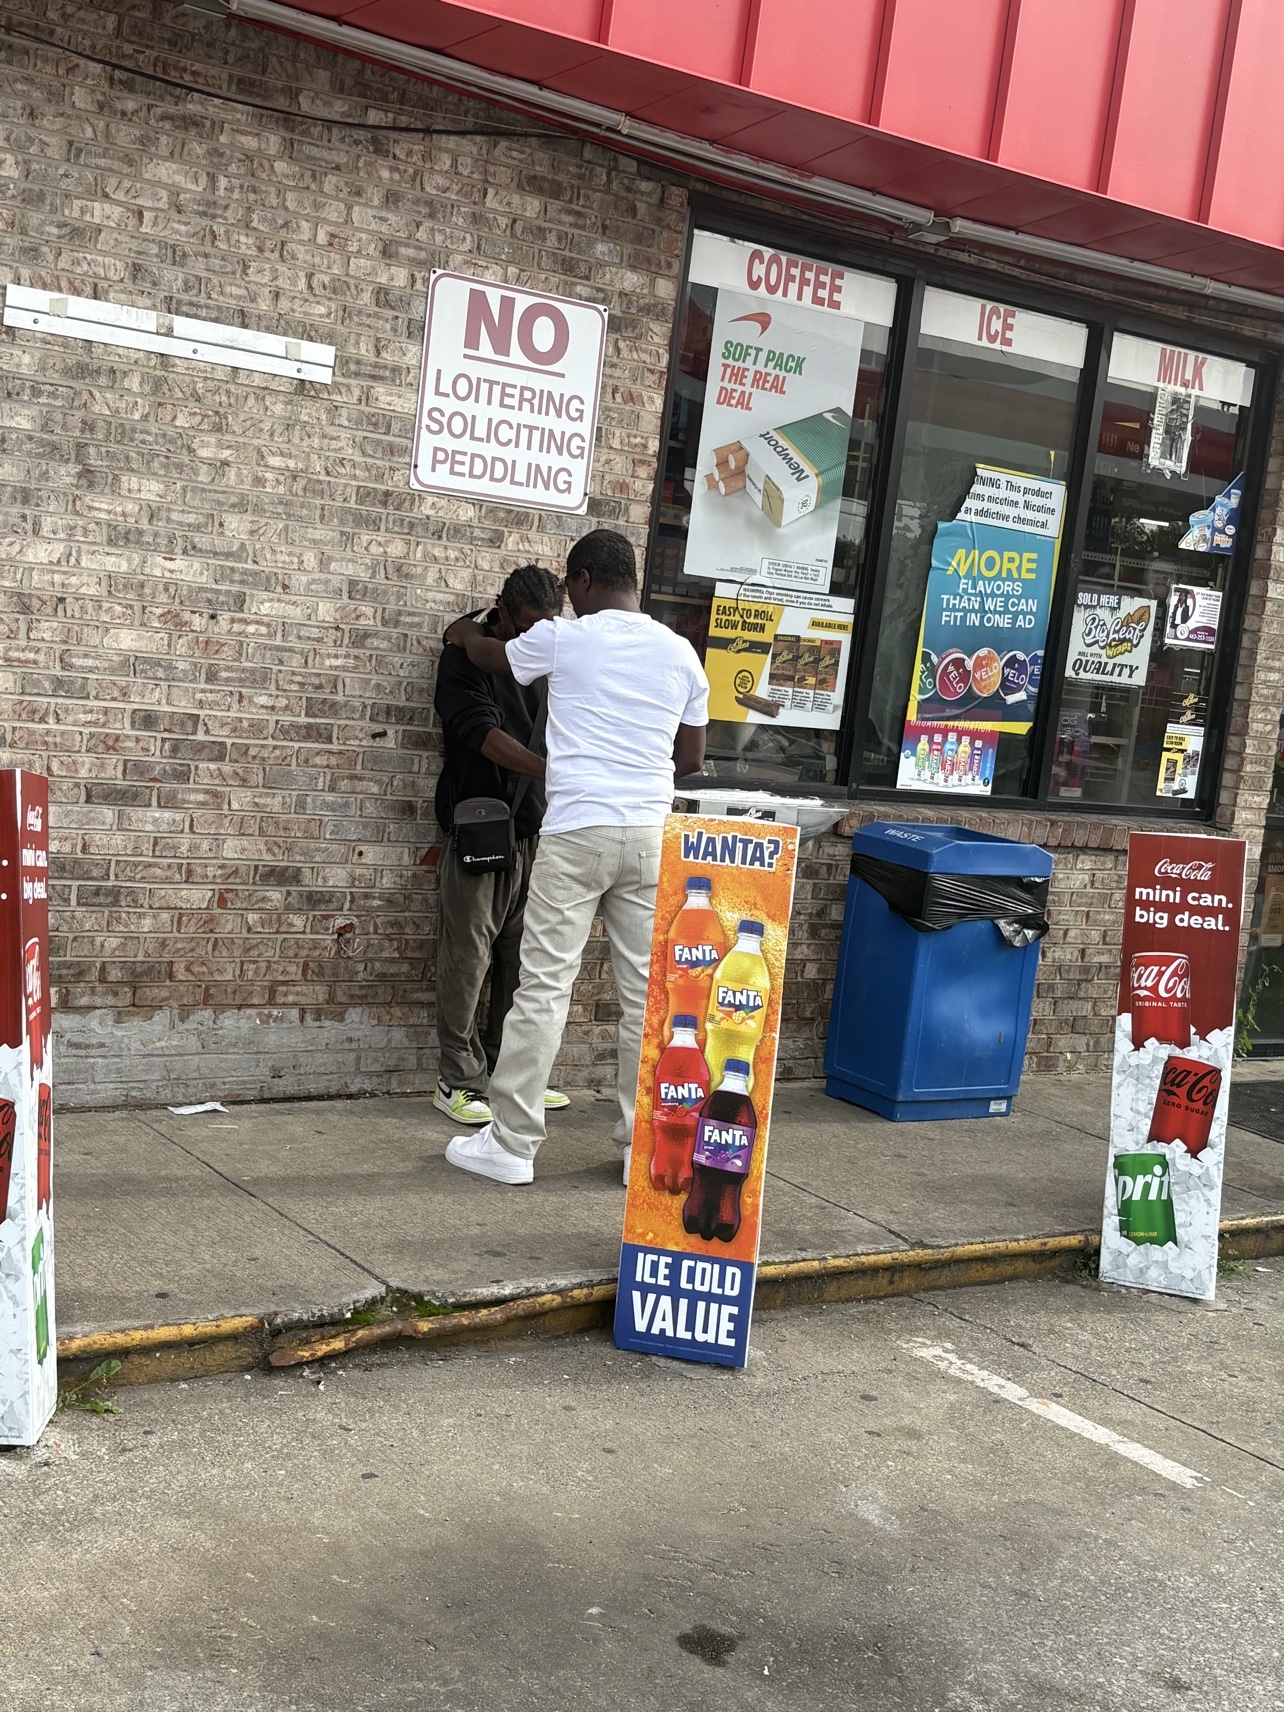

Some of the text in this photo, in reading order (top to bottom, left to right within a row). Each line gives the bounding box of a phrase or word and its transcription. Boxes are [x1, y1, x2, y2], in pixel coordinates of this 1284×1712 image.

[746, 249, 845, 310] COFFEE
[464, 288, 570, 366] NO
[977, 303, 1016, 347] ICE
[721, 340, 806, 376] SOFT PACK
[1157, 347, 1208, 391] MILK
[720, 363, 786, 395] THE REAL
[434, 369, 585, 423] LOITERING
[715, 386, 753, 411] DEAL
[425, 407, 586, 460] SOLICITING
[758, 431, 810, 482] Newport
[431, 446, 573, 495] PEDDLING
[1005, 480, 1021, 493] This
[1023, 485, 1053, 501] product
[987, 493, 1021, 510] nicotine.
[1023, 500, 1056, 516] Nicotine
[974, 507, 1010, 524] addictive
[1012, 512, 1050, 530] chemical.
[946, 549, 1038, 579] MORE
[959, 579, 1023, 595] FLAVORS
[941, 594, 1038, 613] THAN WE CAN
[1077, 592, 1119, 608] SOLD HERE
[714, 617, 766, 634] SLOW BURN
[715, 604, 774, 622] EASY TO ROLL
[941, 612, 1035, 628] FIT IN ONE AD
[811, 620, 849, 632] AVAILABLE HERE
[1083, 614, 1146, 647] Big Leaf
[919, 663, 934, 689] ELO
[946, 662, 964, 693] VELO
[974, 662, 999, 681] VELO
[1003, 666, 1026, 685] VELO
[1029, 665, 1040, 674] VE
[1071, 658, 1139, 678] QUALITY
[917, 748, 925, 778] RECOVER
[930, 750, 940, 780] RECOVER
[943, 750, 954, 784] RECOVER
[957, 753, 967, 783] RECOVER
[971, 755, 980, 782] RECOVER
[26, 804, 43, 832] Coca-Cola
[884, 828, 925, 843] WASTE
[22, 843, 48, 868] mini can.
[463, 854, 505, 864] Champion
[682, 830, 781, 870] WANTA?
[1154, 858, 1216, 881] Coca-Cola
[23, 875, 47, 904] big deal.
[1135, 885, 1233, 908] mini can.
[1135, 906, 1230, 931] big deal.
[674, 944, 719, 962] FANTA
[718, 986, 763, 1007] FANTA
[660, 1082, 705, 1100] FANTA
[1163, 1100, 1209, 1116] ZERO SUGAR
[703, 1125, 749, 1147] FANTA
[1117, 1164, 1170, 1209] prit
[635, 1251, 742, 1297] ICE COLD
[631, 1289, 740, 1348] VALUE
